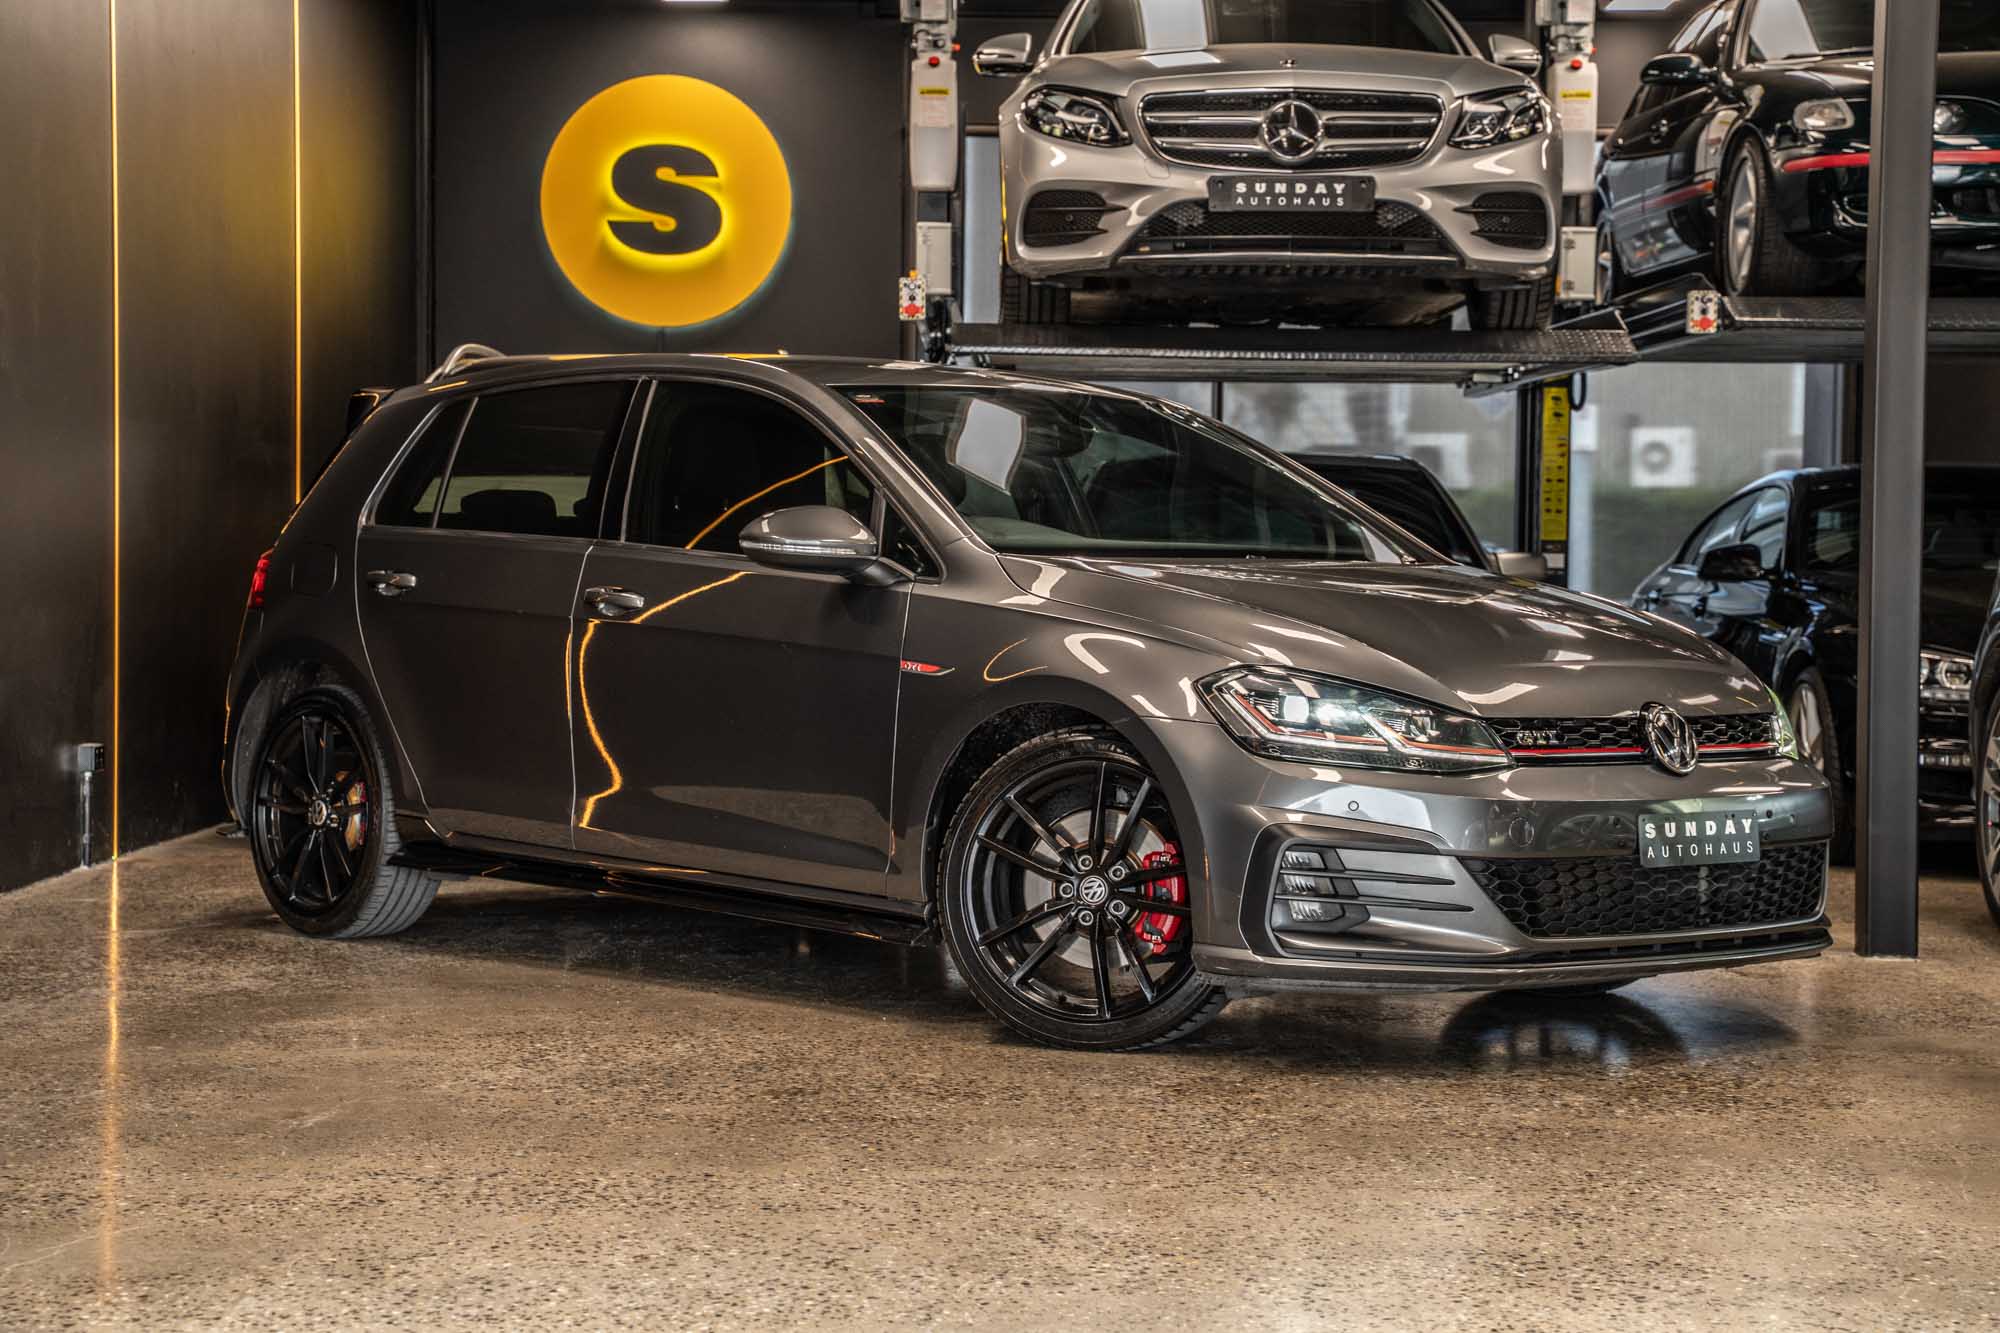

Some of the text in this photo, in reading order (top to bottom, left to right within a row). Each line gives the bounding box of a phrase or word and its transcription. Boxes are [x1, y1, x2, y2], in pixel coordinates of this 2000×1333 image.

[1235, 182, 1346, 194] SUNDAY
[606, 143, 723, 256] S
[1235, 196, 1345, 207] AUTOHAUS
[1644, 818, 1753, 839] SUNDAY
[1647, 840, 1754, 859] AUTOHAUS
